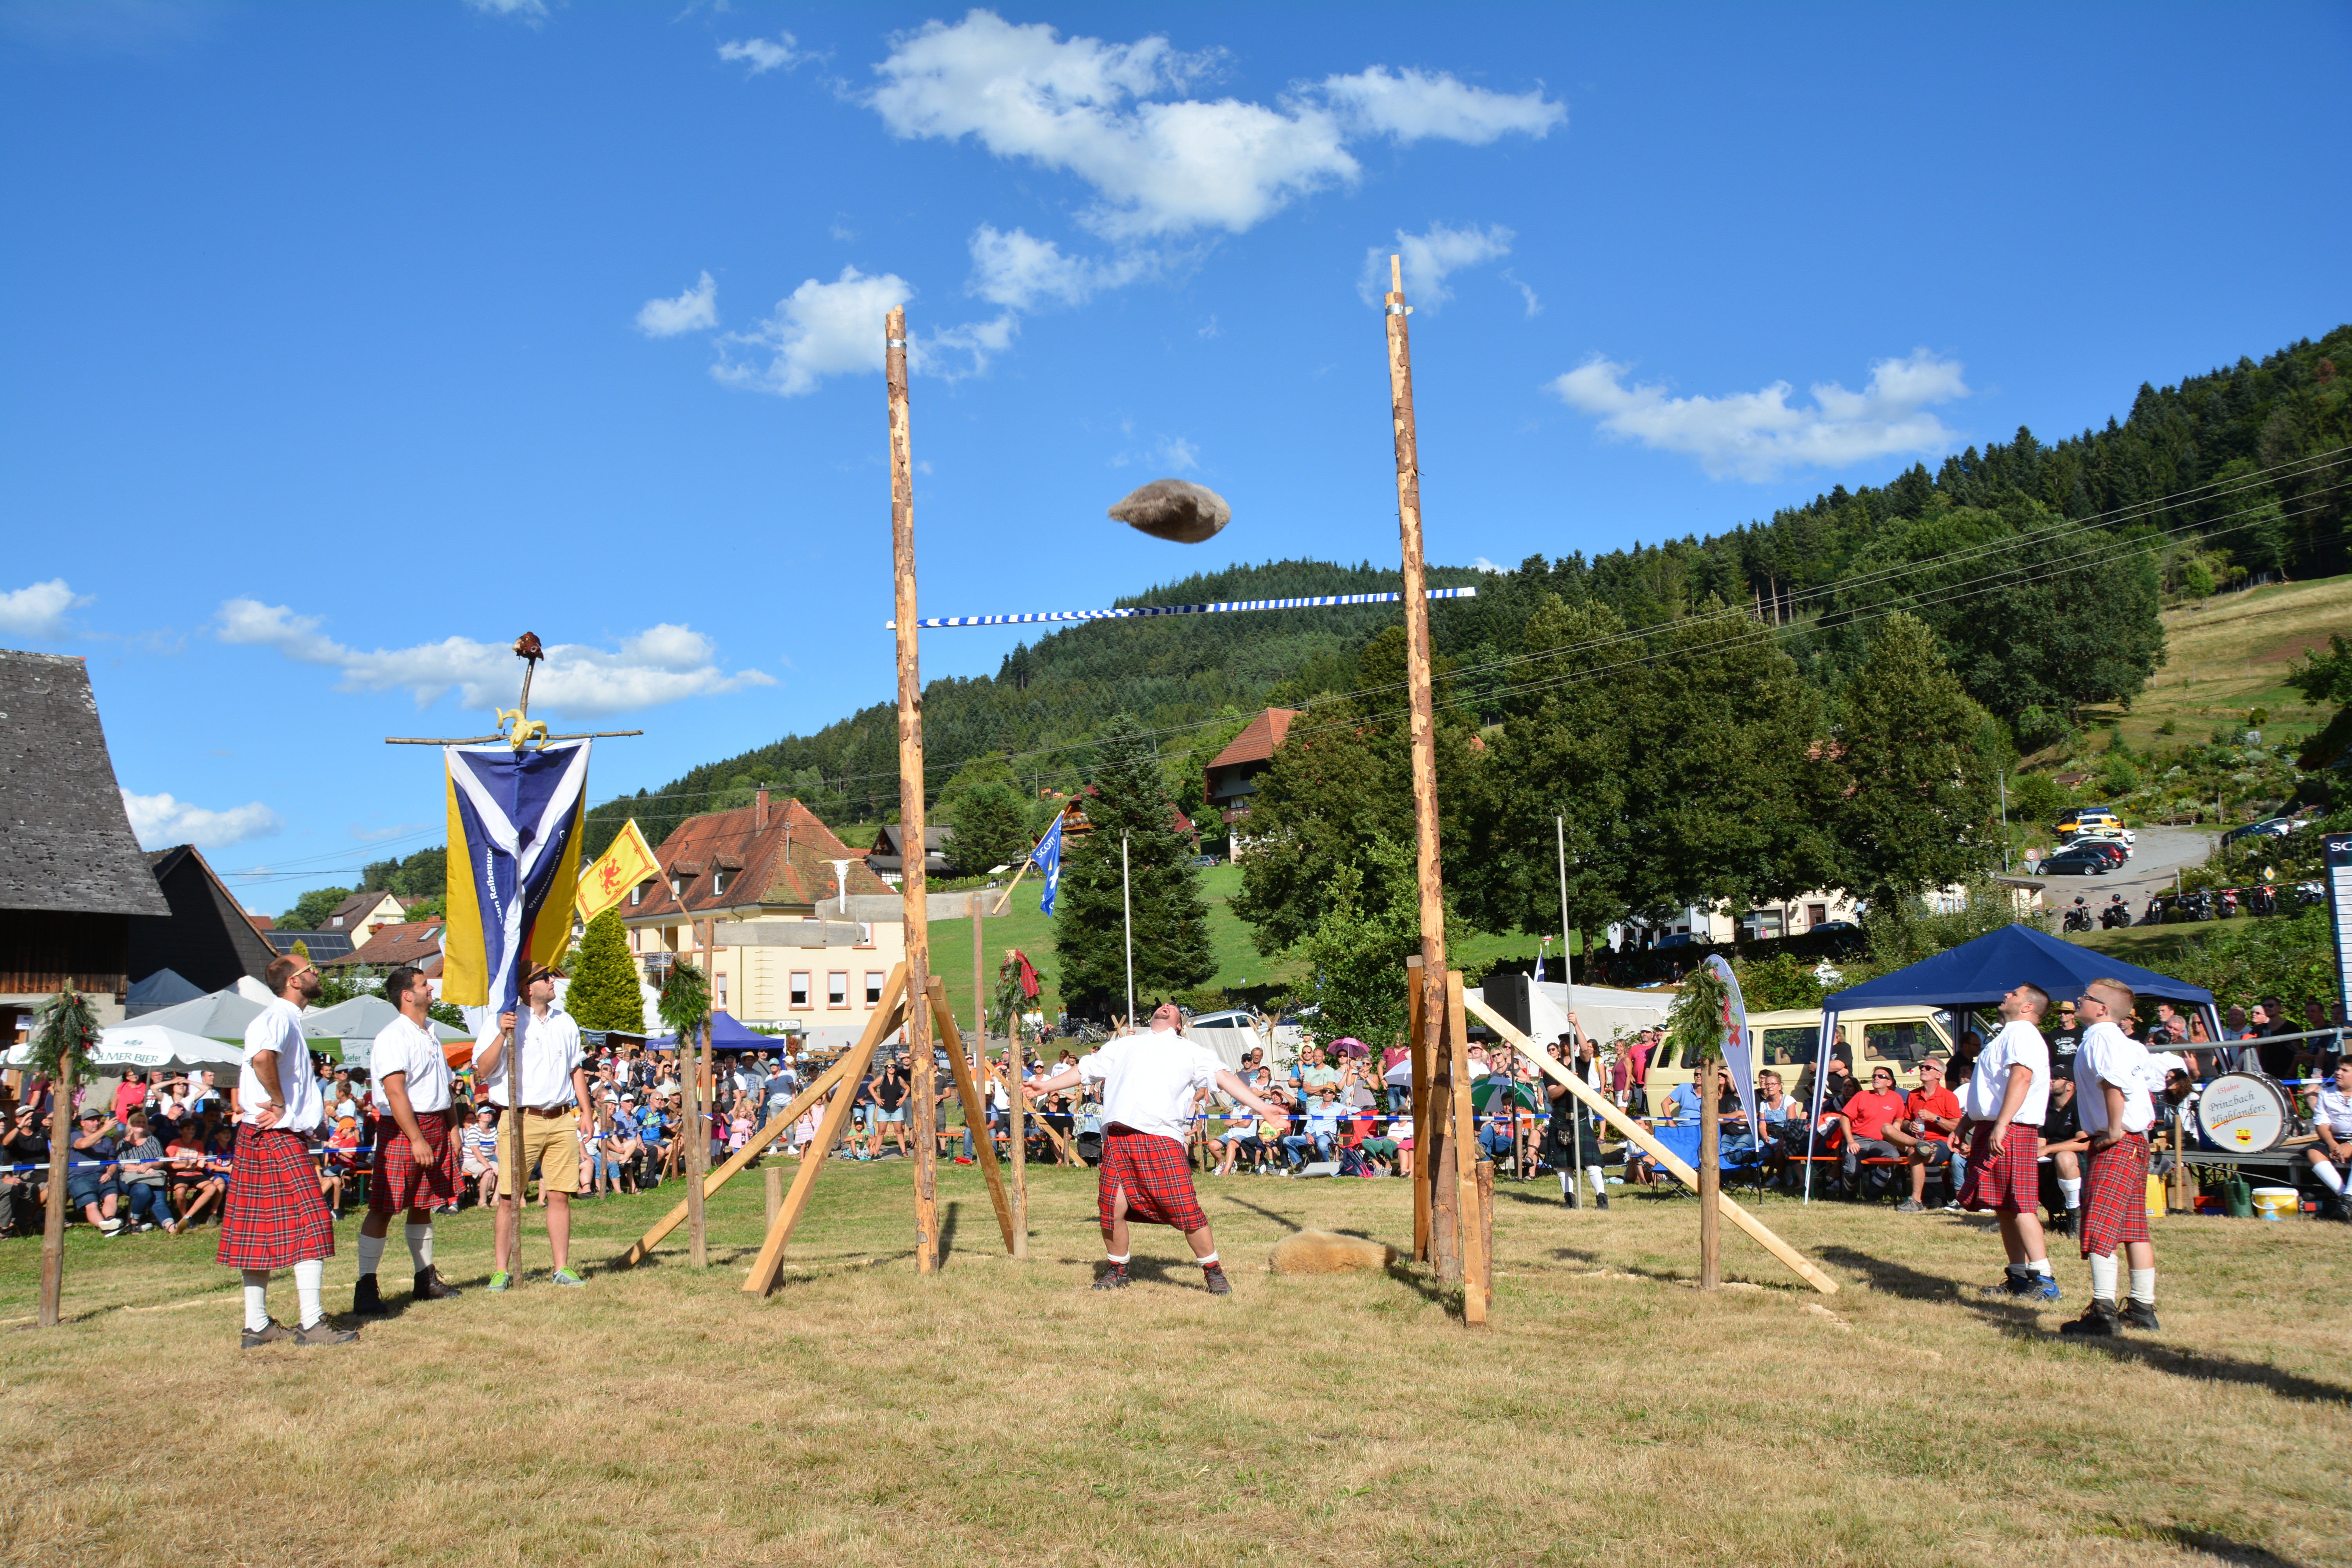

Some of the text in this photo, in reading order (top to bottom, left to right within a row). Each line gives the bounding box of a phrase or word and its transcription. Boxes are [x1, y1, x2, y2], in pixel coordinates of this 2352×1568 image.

[134, 1054, 158, 1063] BIER
[2208, 1091, 2254, 1112] Prinzbach
[2210, 1104, 2266, 1125] Highlanders
